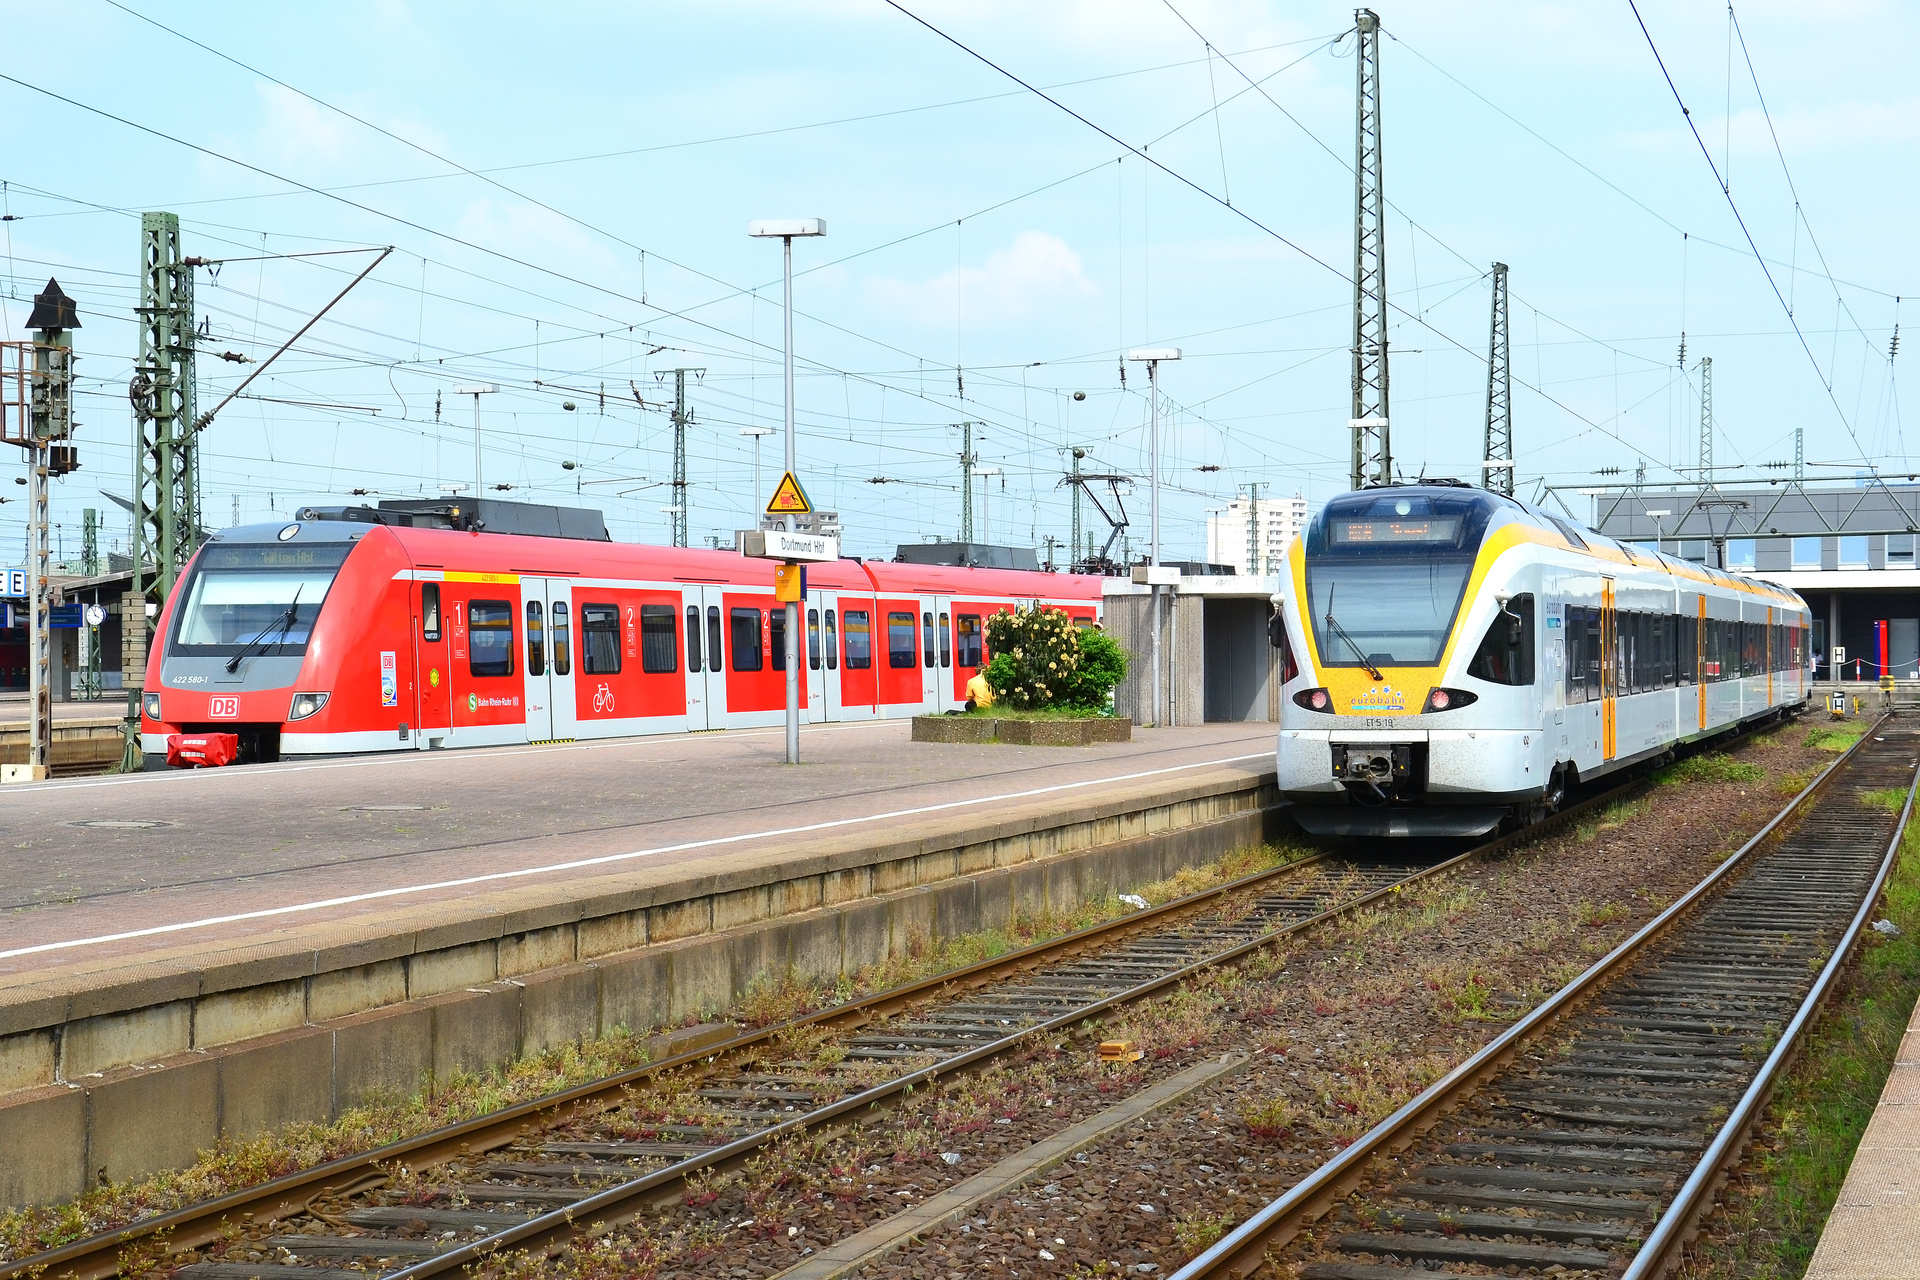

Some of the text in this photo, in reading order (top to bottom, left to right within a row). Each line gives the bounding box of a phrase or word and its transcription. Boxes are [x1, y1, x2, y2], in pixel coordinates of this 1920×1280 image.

[781, 537, 825, 554] Dortmund Hbf
[13, 573, 22, 592] E
[455, 603, 461, 625] 1
[627, 607, 634, 627] 2
[763, 611, 769, 629] 2
[384, 657, 393, 667] DB
[1834, 648, 1843, 662] H
[187, 676, 208, 684] 580-1
[409, 682, 413, 690] 2
[211, 698, 237, 716] DB
[469, 695, 477, 710] S
[478, 698, 489, 706] Bahn
[489, 697, 512, 706] Rhein-Ruhr
[1351, 696, 1405, 704] eurobahn
[1834, 699, 1844, 710] H
[1366, 718, 1374, 727] ET
